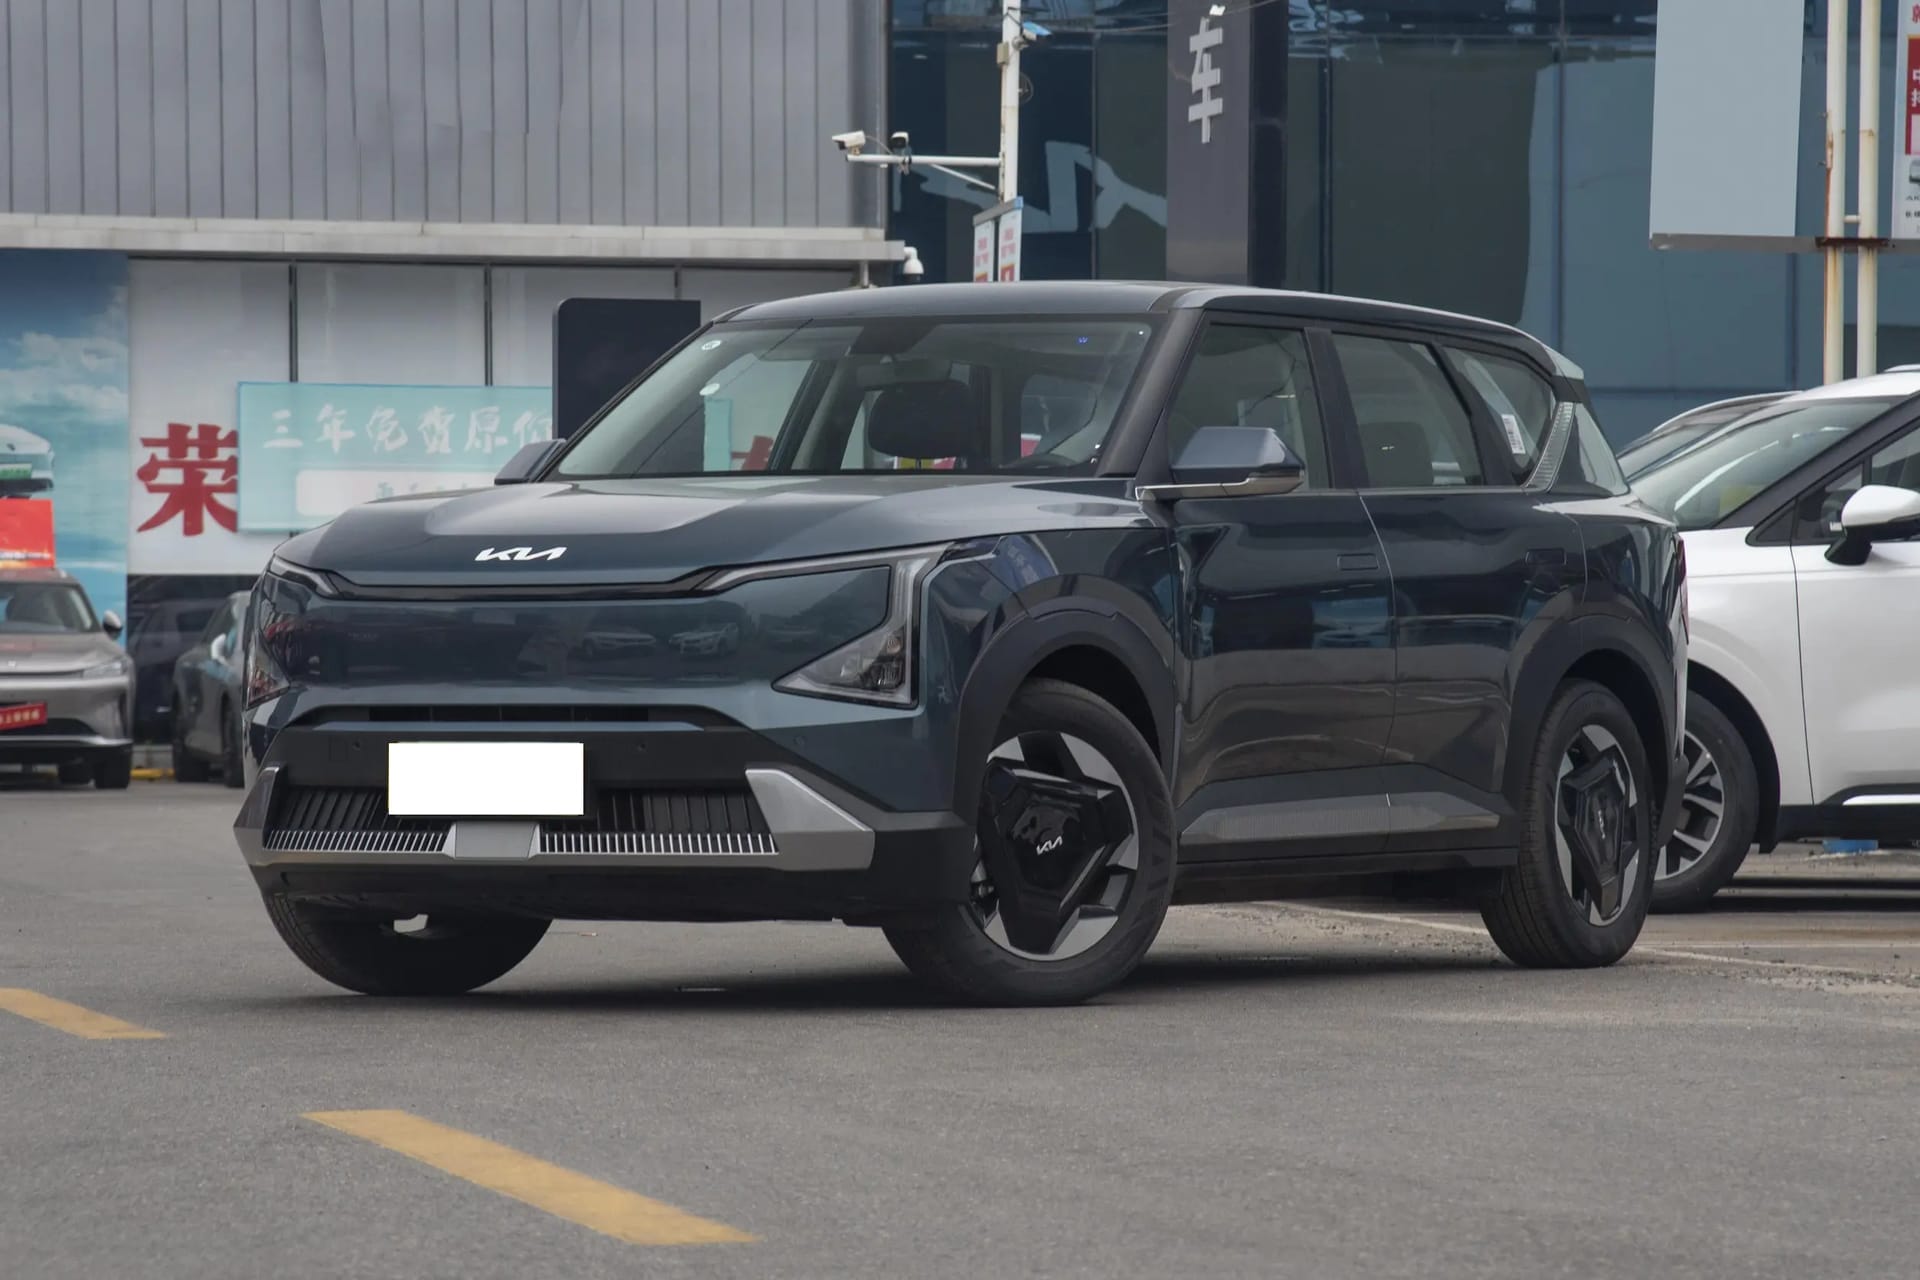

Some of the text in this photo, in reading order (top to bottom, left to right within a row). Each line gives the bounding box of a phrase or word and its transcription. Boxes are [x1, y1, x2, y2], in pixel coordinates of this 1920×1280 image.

[1188, 17, 1223, 143] 车
[137, 423, 238, 536] 荣
[475, 546, 567, 561] KIA
[1036, 835, 1063, 855] KIA
